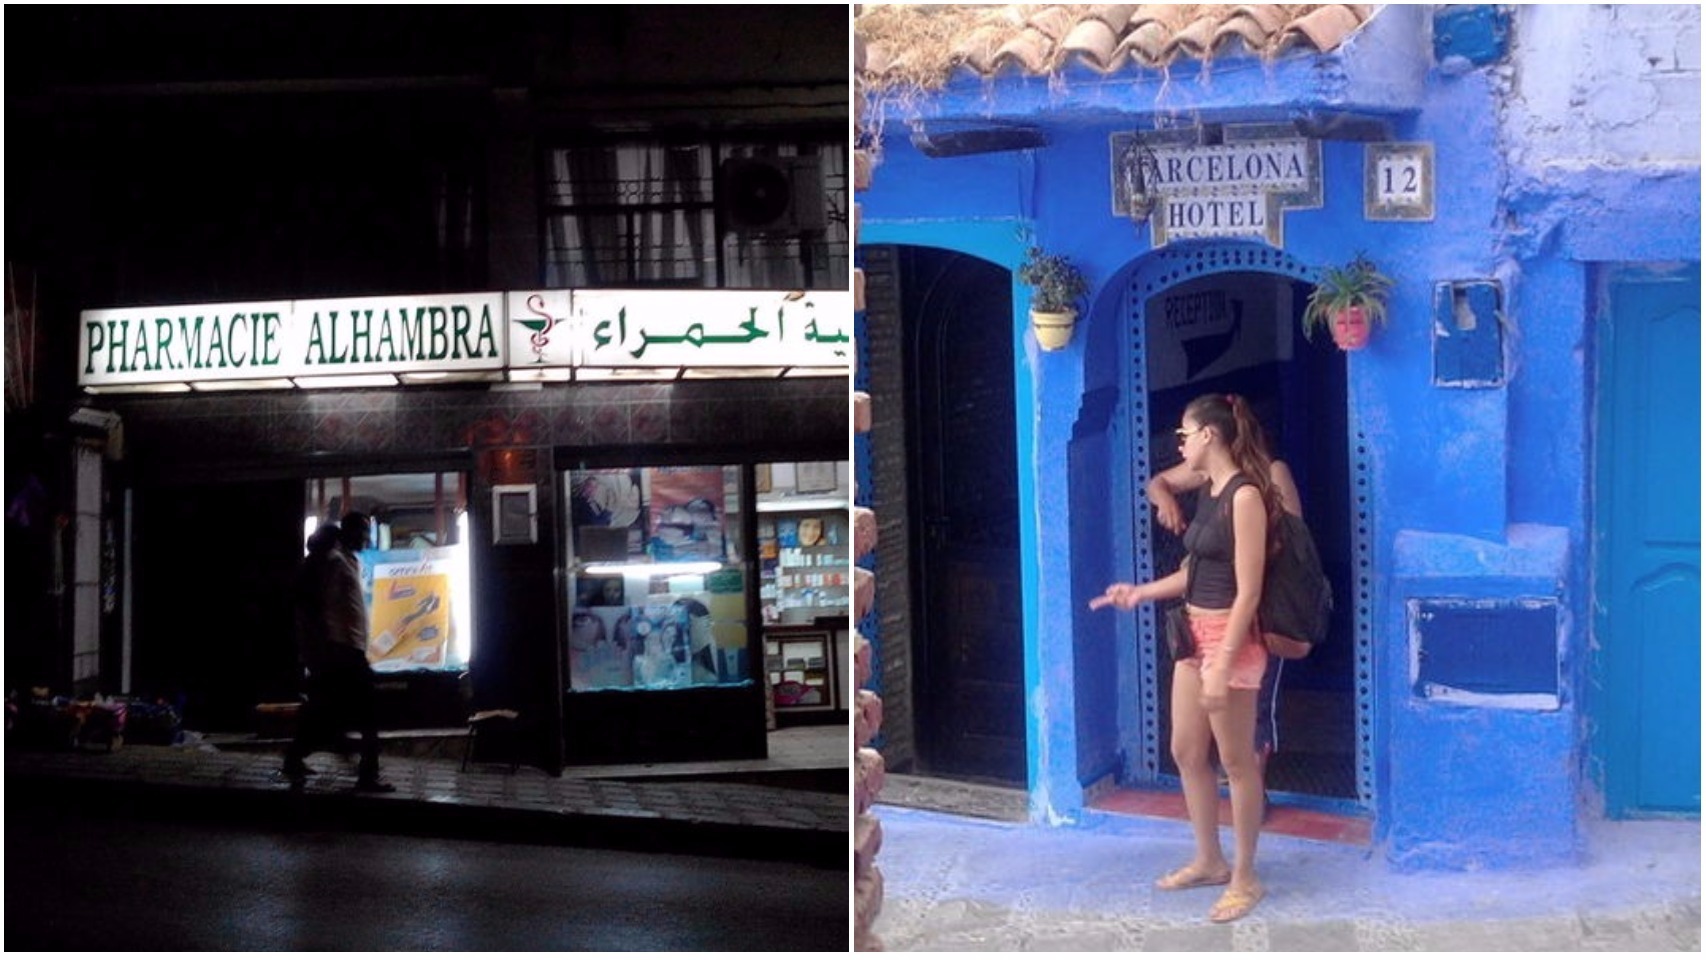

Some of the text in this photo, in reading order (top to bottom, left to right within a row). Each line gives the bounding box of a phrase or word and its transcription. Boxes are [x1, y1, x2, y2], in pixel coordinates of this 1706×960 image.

[1147, 150, 1303, 184] ARCELONA
[1382, 166, 1418, 194] 12
[1167, 200, 1264, 229] HOTEL
[84, 303, 499, 375] PHARMACIE ALHAMBRA
[593, 304, 784, 360] الحمراء
